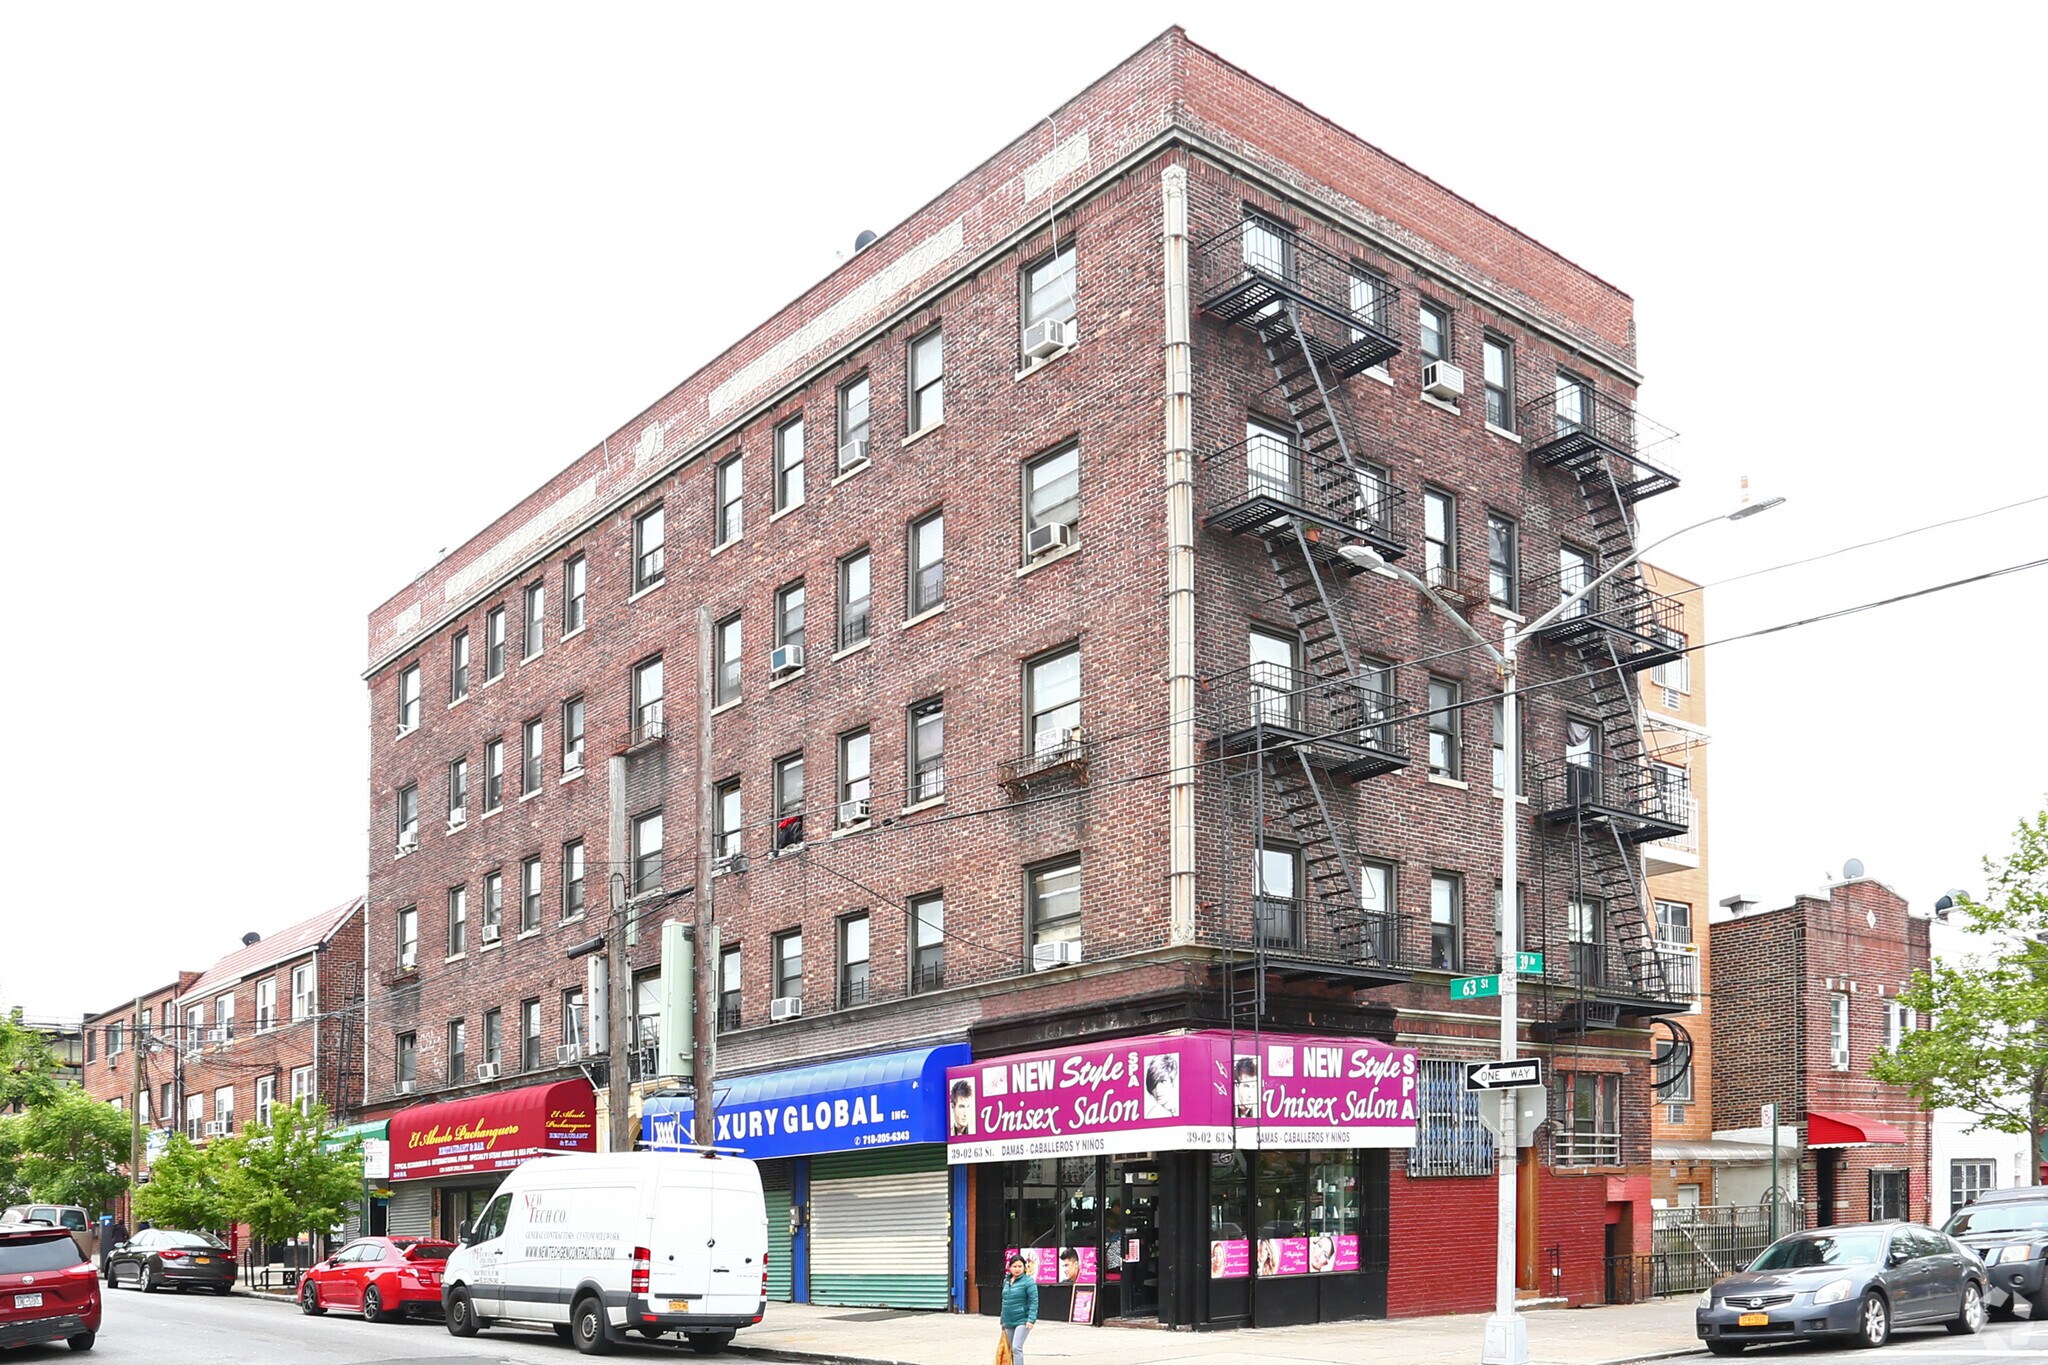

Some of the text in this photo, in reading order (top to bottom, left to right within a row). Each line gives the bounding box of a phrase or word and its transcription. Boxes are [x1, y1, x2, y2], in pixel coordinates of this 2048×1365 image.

[1519, 954, 1529, 970] 39
[1462, 978, 1489, 996] 63 St
[1012, 1059, 1056, 1094] NEW
[1058, 1052, 1125, 1092] Style
[1127, 1051, 1141, 1088] SPA
[1302, 1046, 1344, 1078] NEW
[1348, 1049, 1401, 1085] Style
[1481, 1068, 1531, 1081] ONE WAY
[1401, 1053, 1416, 1120] SPA
[980, 1089, 1140, 1135] Unisex Salon
[1262, 1084, 1398, 1126] Unisex Salon
[690, 1109, 778, 1143] XURY
[783, 1095, 884, 1134] GLOBAL
[891, 1110, 909, 1121] INC.
[408, 1118, 520, 1149] El Abuelo Pachanguero
[862, 1130, 910, 1145] 718-205-6343
[1186, 1131, 1212, 1143] 39-02
[1215, 1131, 1226, 1143] 63
[1283, 1130, 1324, 1144] CABALLEROS
[1325, 1131, 1331, 1143] Y
[1331, 1128, 1351, 1143] NIÑOS
[951, 1148, 973, 1160] 39-02
[973, 1147, 984, 1158] 63
[1001, 1143, 1025, 1156] DAMAS
[1029, 1140, 1074, 1155] CABALLEROS
[1075, 1140, 1081, 1151] Y
[1082, 1138, 1105, 1151] NIÑOS
[529, 1206, 552, 1223] TECH
